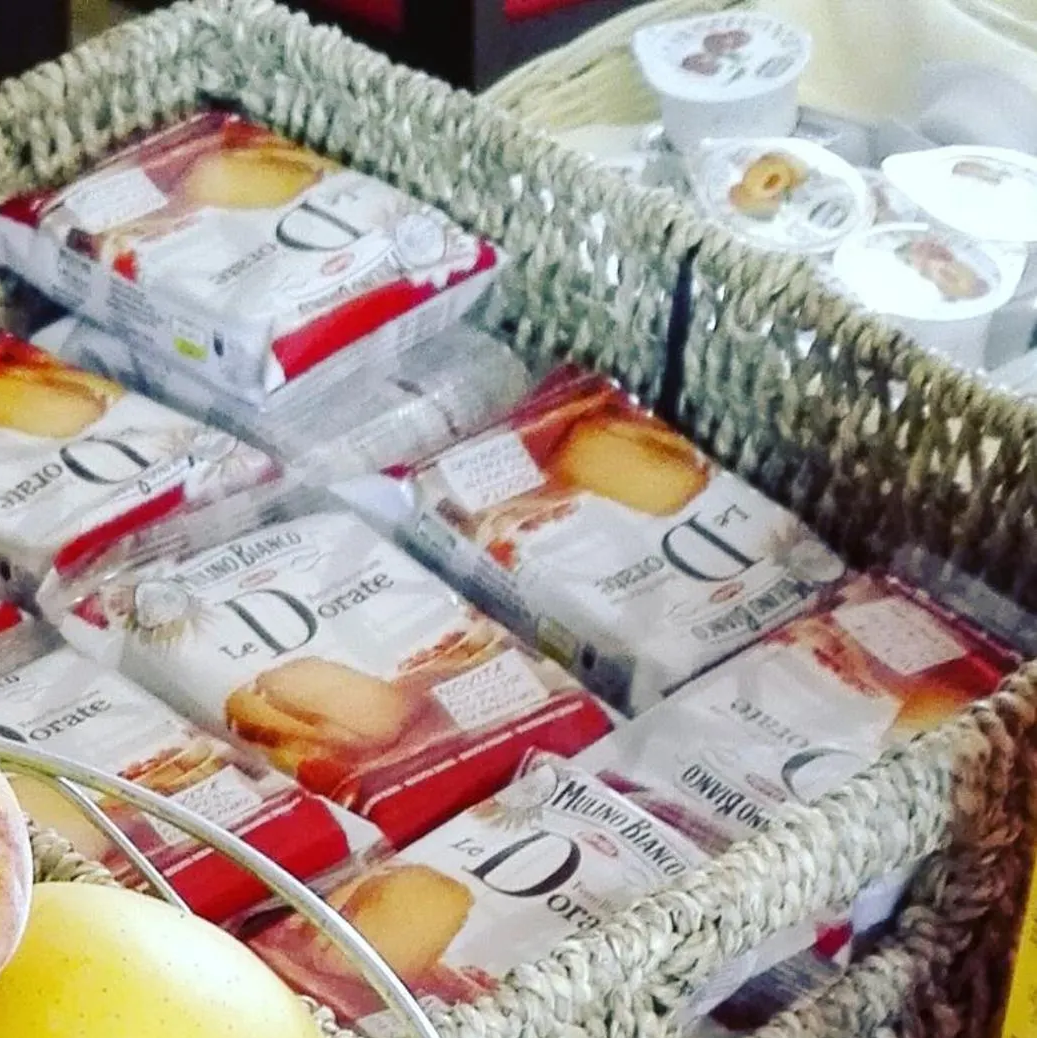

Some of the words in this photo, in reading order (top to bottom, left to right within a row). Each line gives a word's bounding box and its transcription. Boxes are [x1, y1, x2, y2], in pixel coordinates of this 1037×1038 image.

[593, 511, 765, 594] Dorate
[216, 571, 395, 660] Dorate
[218, 641, 260, 661] Le
[551, 778, 627, 828] MULINO
[618, 817, 688, 878] BIANCO
[460, 829, 602, 931] Dora
